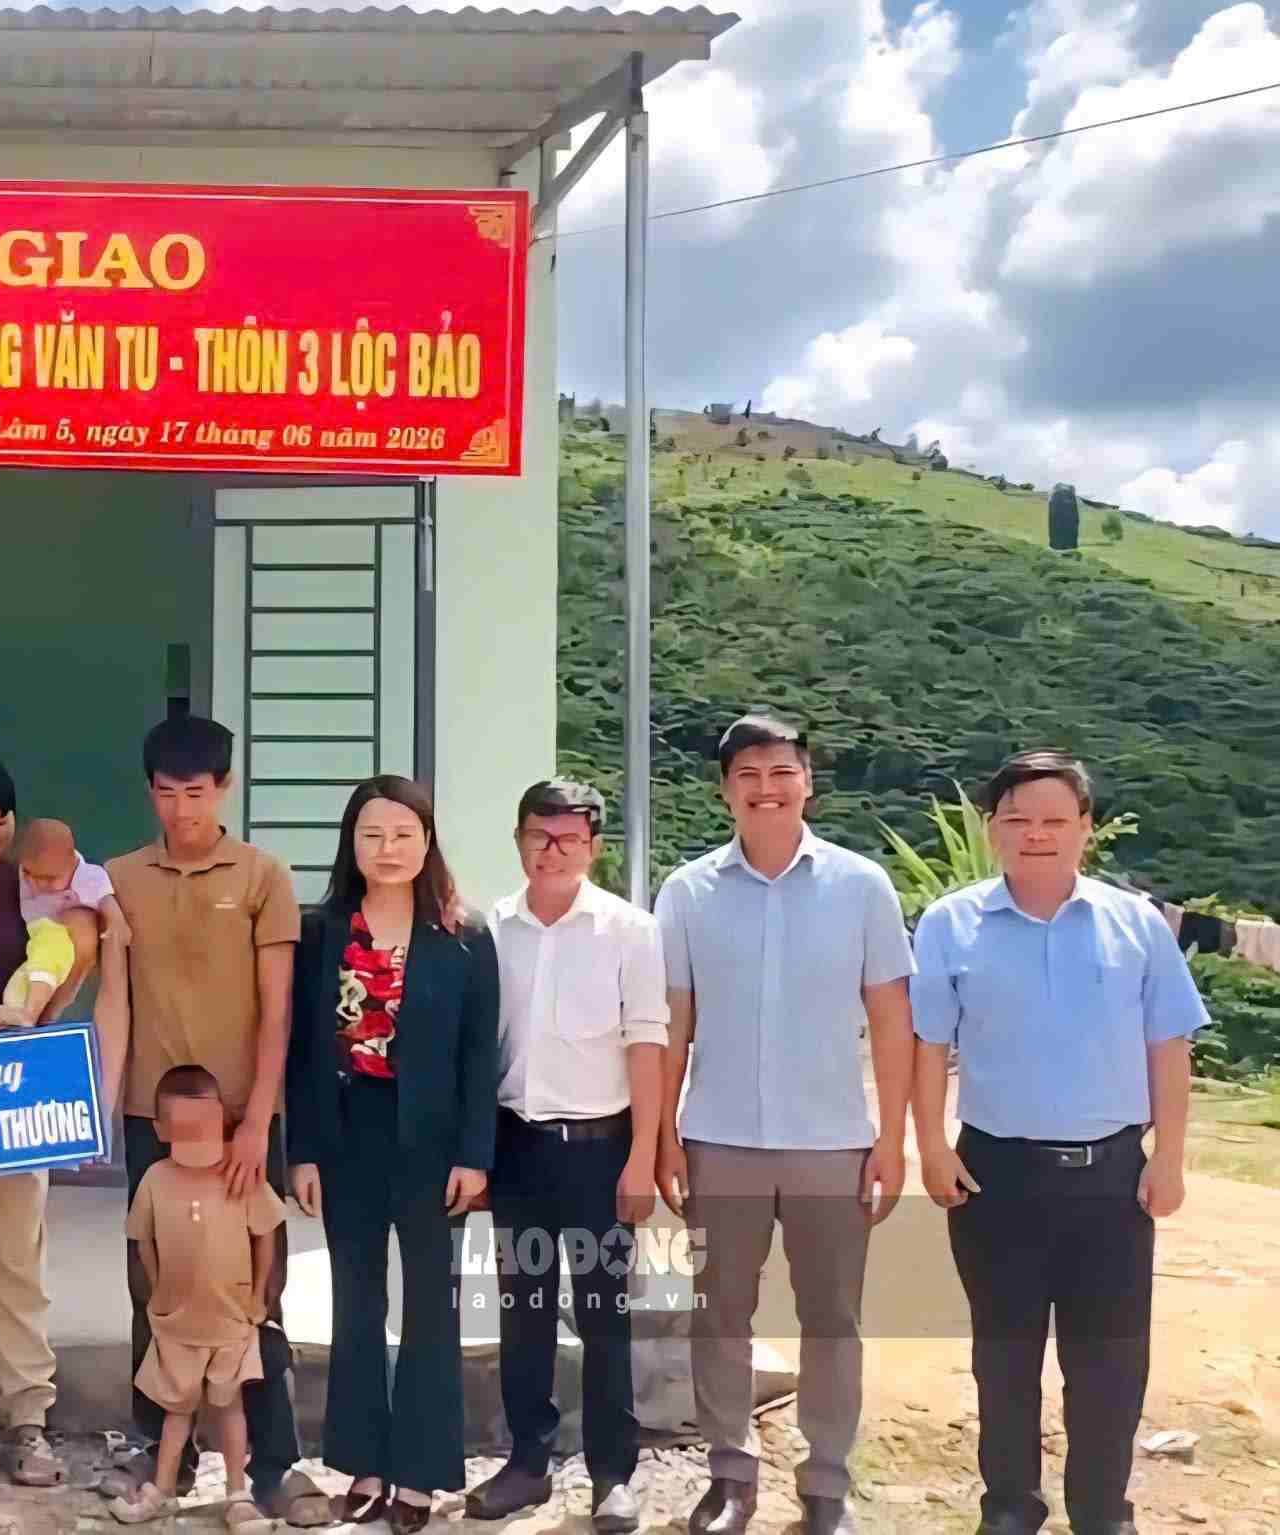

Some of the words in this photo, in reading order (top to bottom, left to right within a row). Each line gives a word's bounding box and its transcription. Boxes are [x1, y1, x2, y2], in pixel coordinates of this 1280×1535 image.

[34, 309, 104, 390] VĂN
[115, 326, 159, 391] TU
[169, 356, 183, 371] -
[194, 315, 288, 394] THÔN
[298, 330, 319, 394] 3
[331, 317, 397, 410] LỘC
[409, 310, 481, 398] BẢO
[56, 418, 76, 444] 5,
[86, 420, 150, 447] ngày
[160, 420, 188, 443] 17
[195, 421, 273, 449] tháng
[283, 424, 312, 446] 06
[320, 427, 377, 448] năm
[385, 427, 446, 449] 2026
